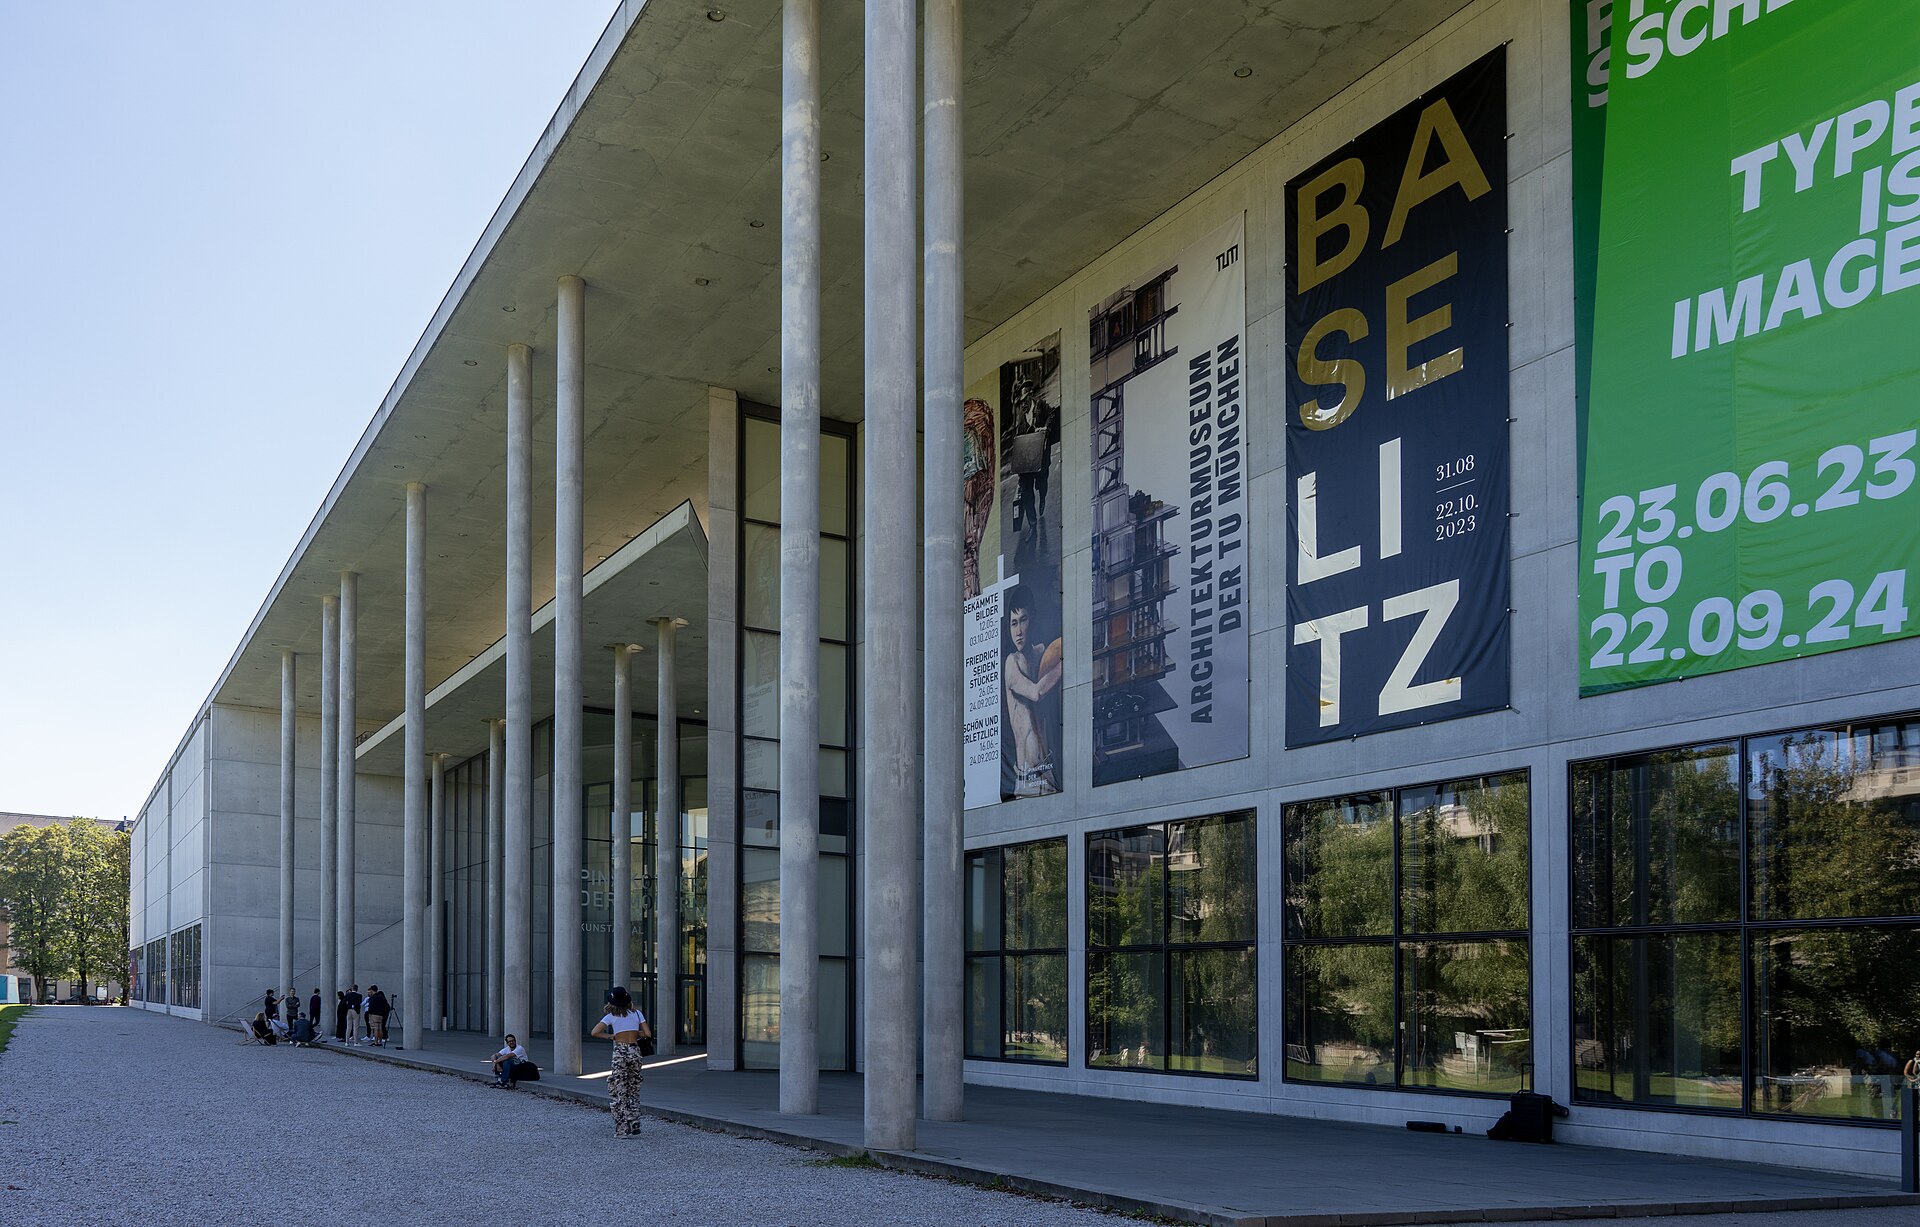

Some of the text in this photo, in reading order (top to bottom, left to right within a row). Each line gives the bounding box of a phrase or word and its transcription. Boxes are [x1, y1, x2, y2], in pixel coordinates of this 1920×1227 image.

[1730, 81, 1920, 213] TYPE
[1298, 97, 1492, 295] BA
[1859, 152, 1920, 235] IS
[1671, 222, 1920, 359] IMAGE
[1297, 251, 1463, 431] SE
[1215, 334, 1242, 634] DER TU MÜNCHEN
[1436, 454, 1475, 482] 31.08
[1596, 428, 1917, 553] 23.06.23
[1189, 350, 1213, 723] ARCHITEKTURMUSEUM
[1297, 437, 1402, 585] LI
[1435, 494, 1479, 520] 22.10.
[1435, 515, 1476, 541] 2023
[1593, 546, 1682, 609] TO
[970, 628, 998, 646] 03.10.2023
[976, 604, 998, 621] BILDER
[1589, 569, 1908, 669] 22.09.24
[966, 648, 998, 667] FRIEDRICH
[970, 672, 998, 688] STÜCKER
[973, 661, 998, 676] SEIDEN-
[1293, 578, 1462, 727] TZ
[970, 695, 998, 712] 24.09.2023
[985, 715, 998, 727] UND
[970, 750, 998, 766] 24.09.2023
